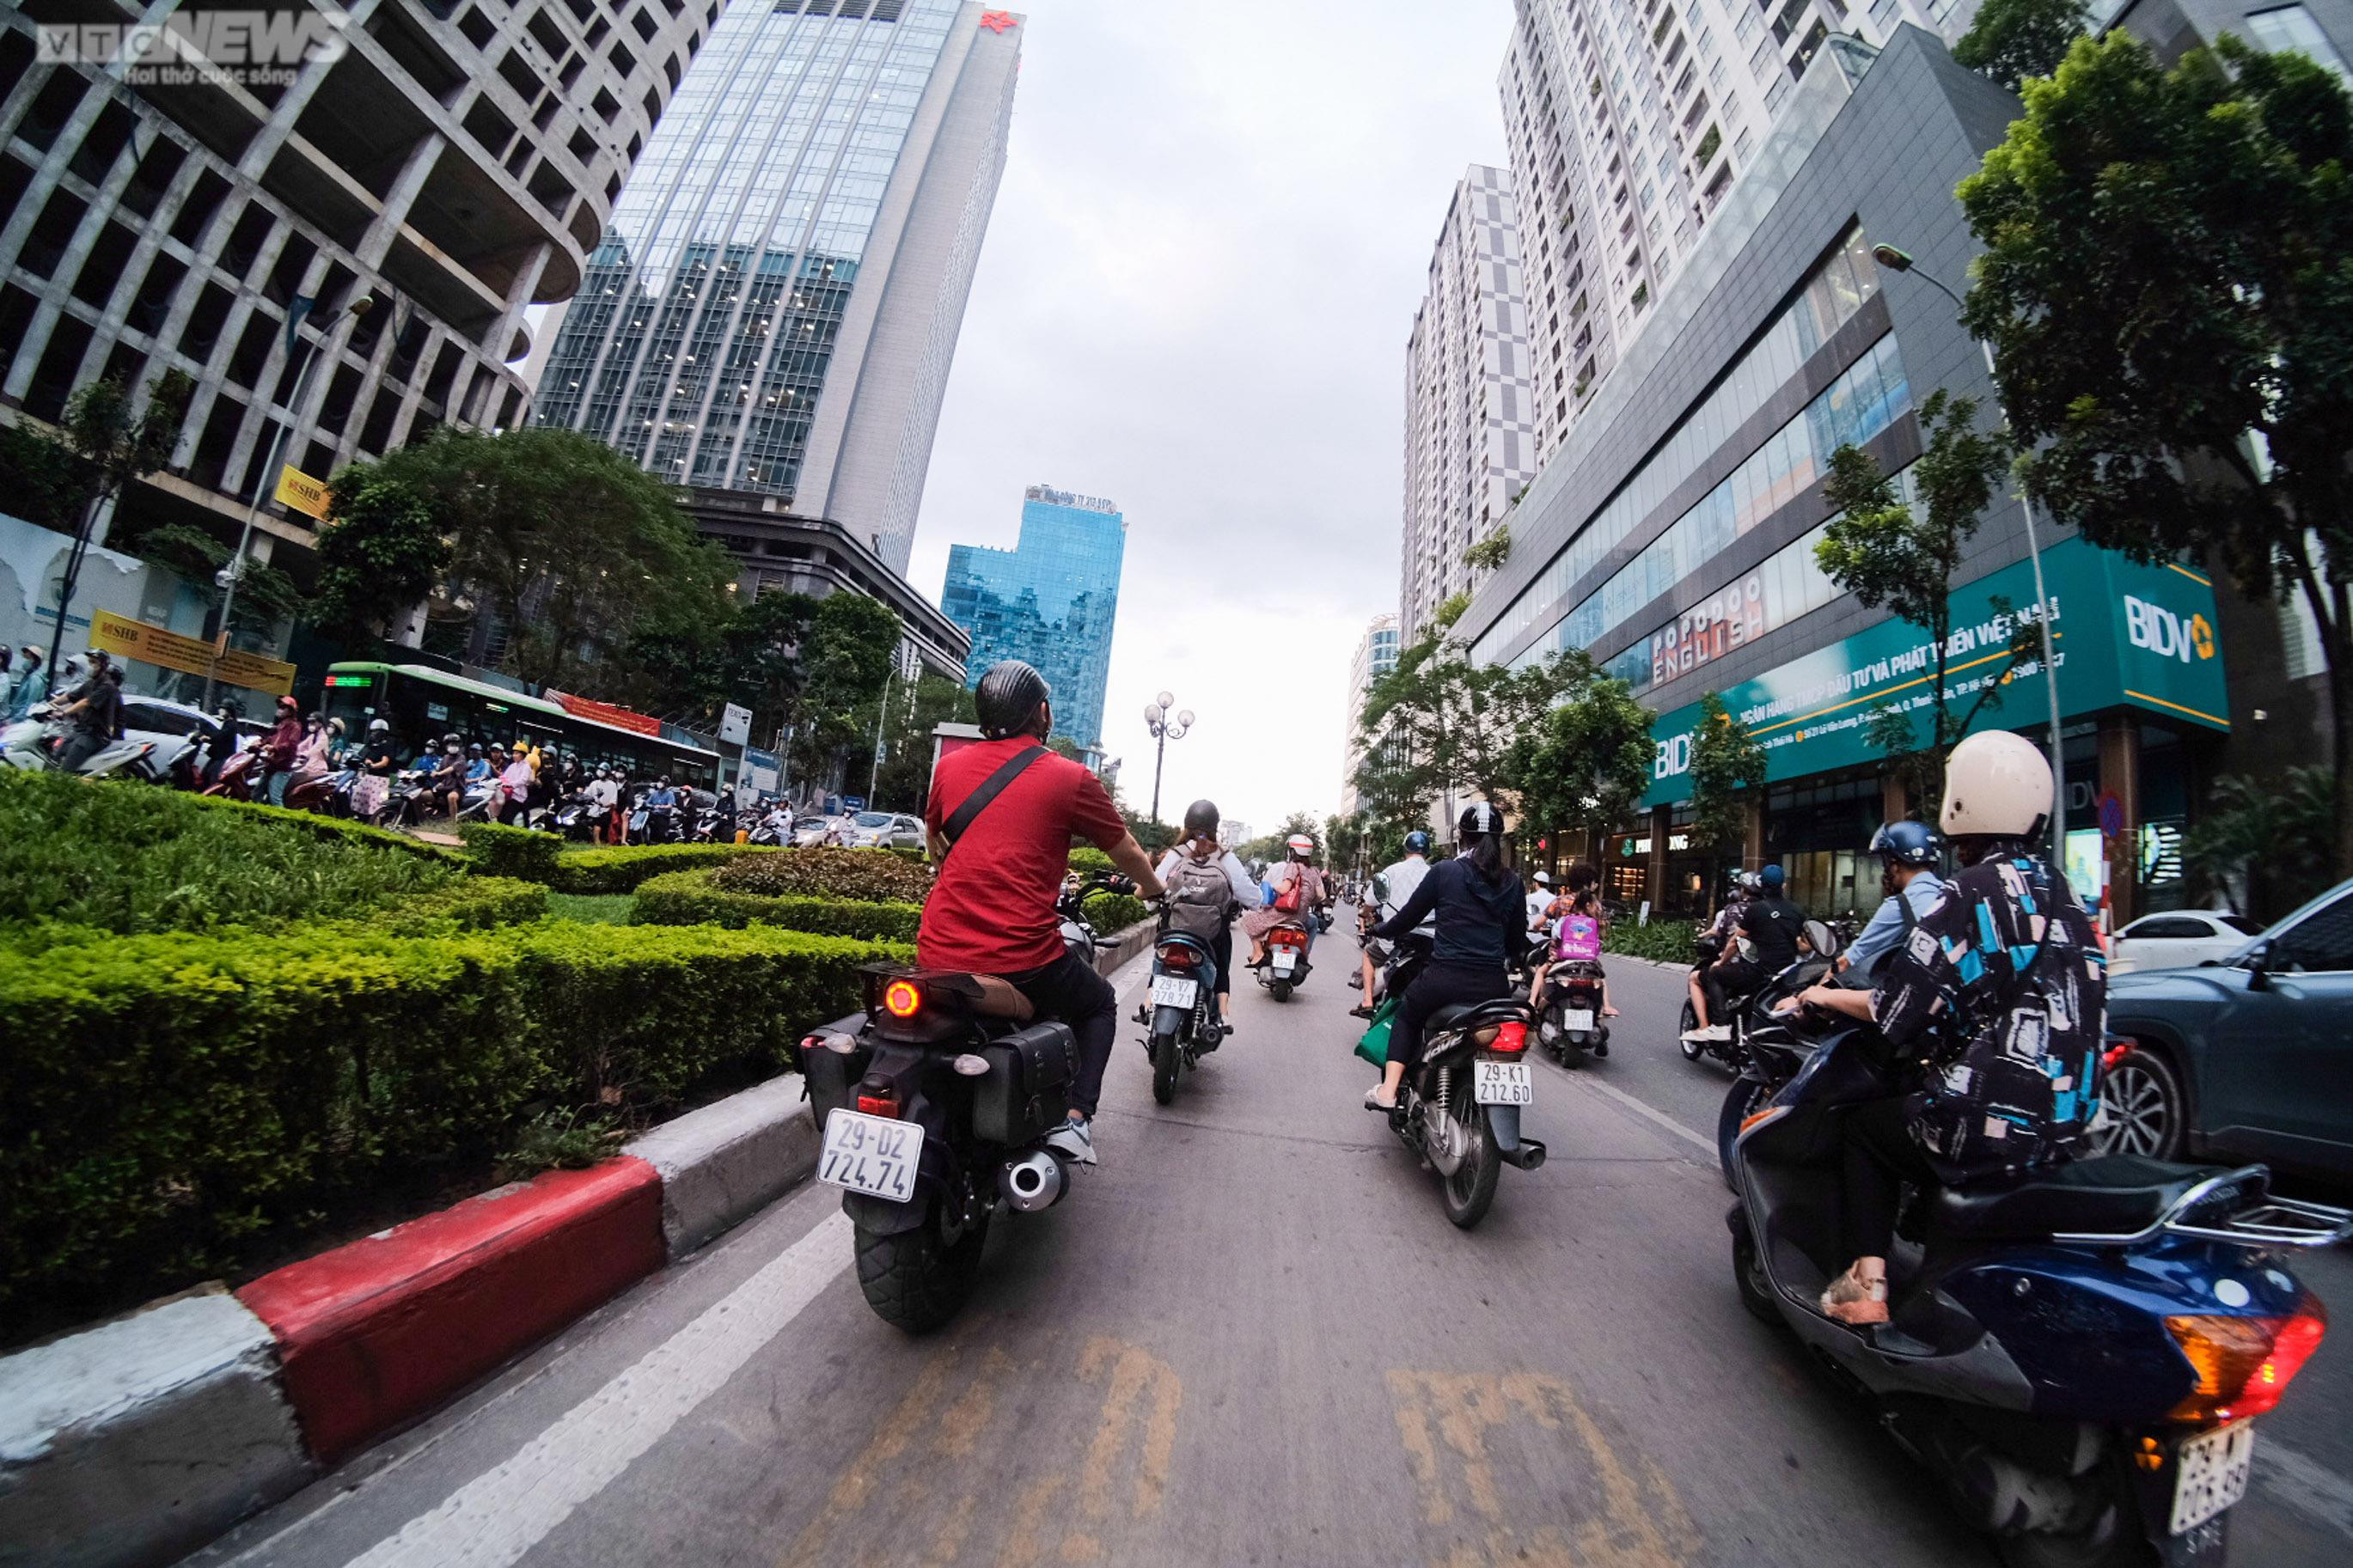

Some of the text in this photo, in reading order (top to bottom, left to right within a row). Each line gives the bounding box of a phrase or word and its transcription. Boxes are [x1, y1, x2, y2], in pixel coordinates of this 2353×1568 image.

[297, 485, 321, 502] SHB
[113, 625, 139, 642] SHB
[1652, 575, 1761, 659] POPODOO
[2123, 594, 2192, 663] BIDV
[1653, 611, 1763, 685] ENGLISH
[1871, 656, 1890, 682] VÀ
[1890, 644, 1928, 677] PHÁT
[1655, 730, 1707, 780] BID
[1480, 1083, 1530, 1102] 212.60
[1484, 1064, 1524, 1083] 29-K1
[838, 1118, 907, 1159] 29-D2
[823, 1149, 905, 1195] 724.74
